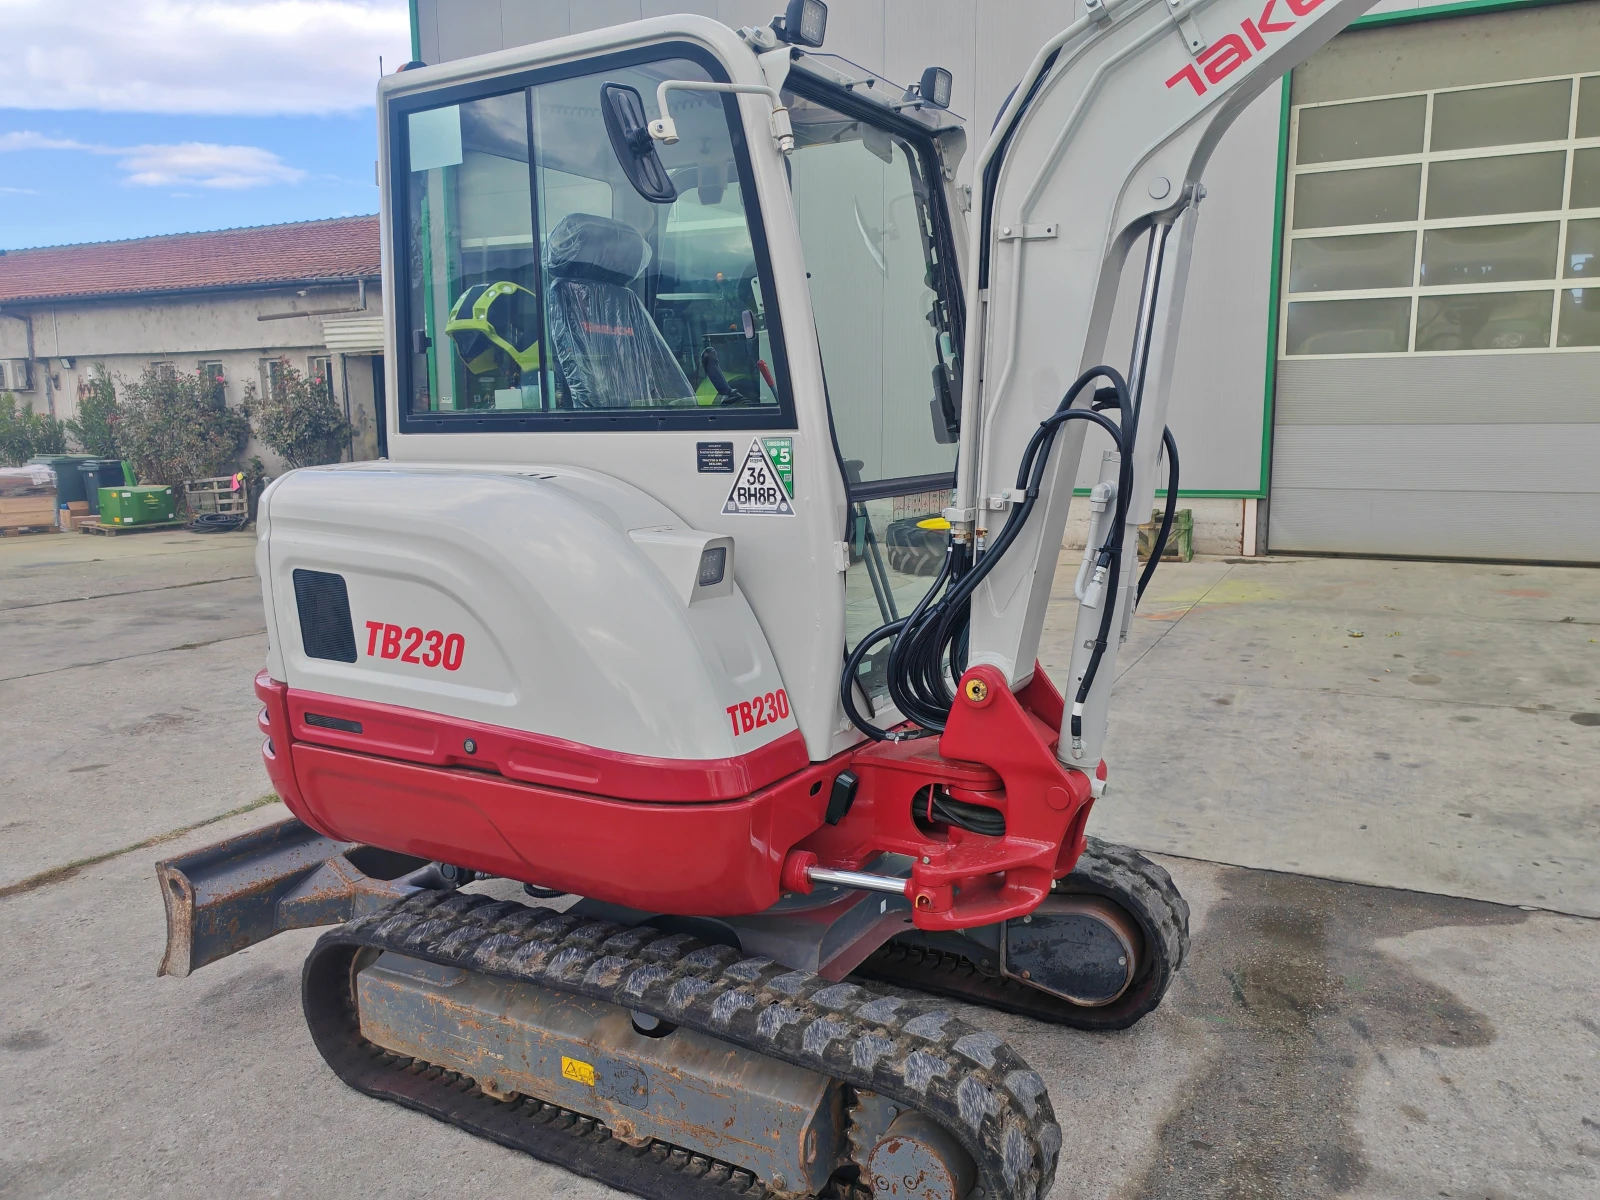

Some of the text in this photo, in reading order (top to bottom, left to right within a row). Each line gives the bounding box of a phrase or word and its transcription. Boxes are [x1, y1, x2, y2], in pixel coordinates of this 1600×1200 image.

[780, 448, 790, 462] 5
[747, 467, 766, 485] 36
[737, 487, 777, 505] BH8B
[365, 620, 466, 671] TB230
[726, 688, 790, 737] TB230
